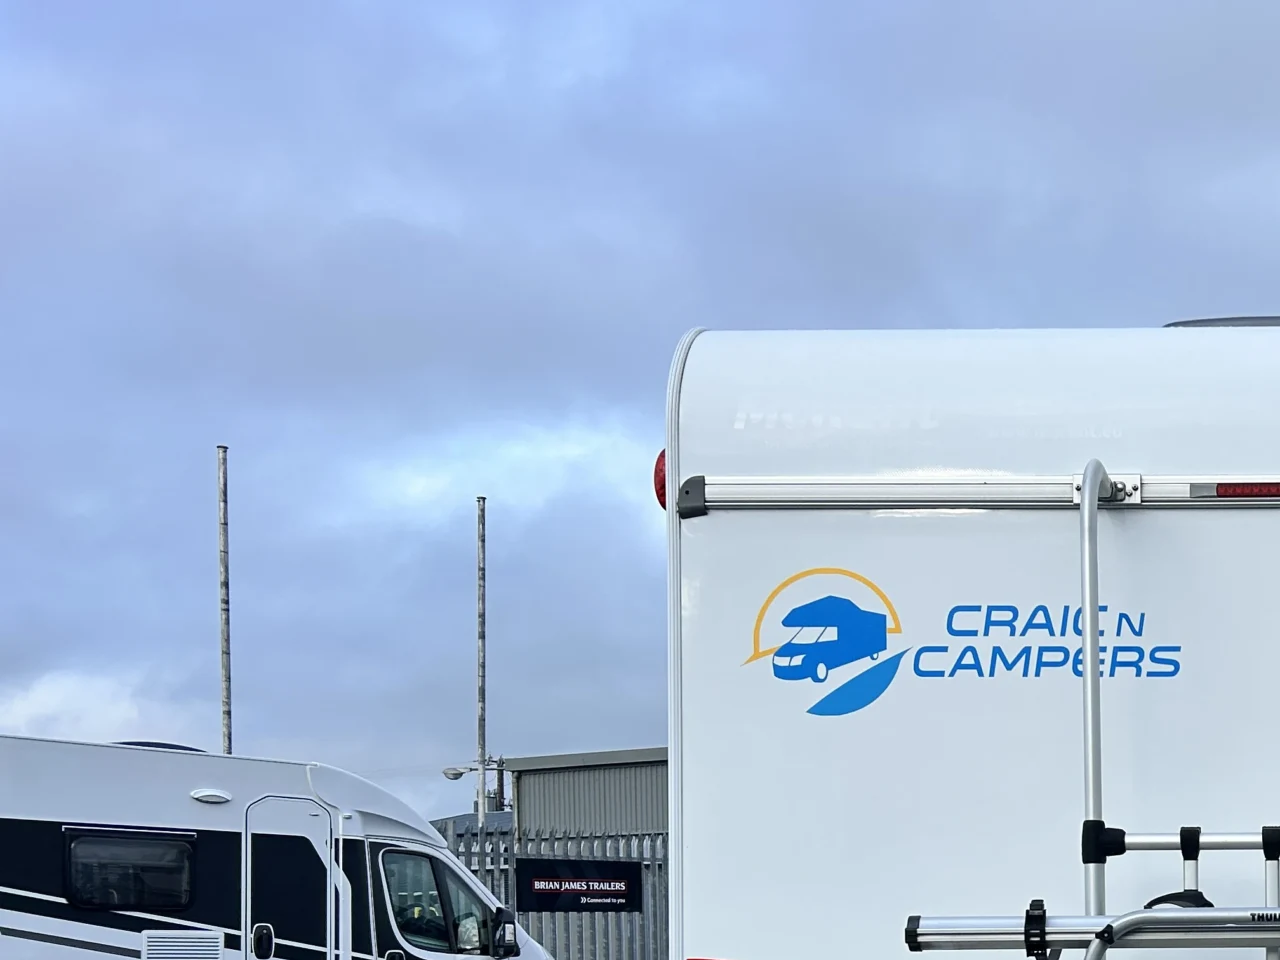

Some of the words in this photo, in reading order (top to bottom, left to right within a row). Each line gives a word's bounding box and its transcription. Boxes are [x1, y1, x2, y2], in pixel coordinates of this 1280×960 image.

[946, 604, 1109, 638] CRAIC
[1116, 612, 1145, 637] N
[912, 645, 1182, 679] CAMPERS
[534, 881, 560, 890] BRIAN
[560, 881, 587, 891] JAMES
[588, 882, 626, 890] TRAILERS
